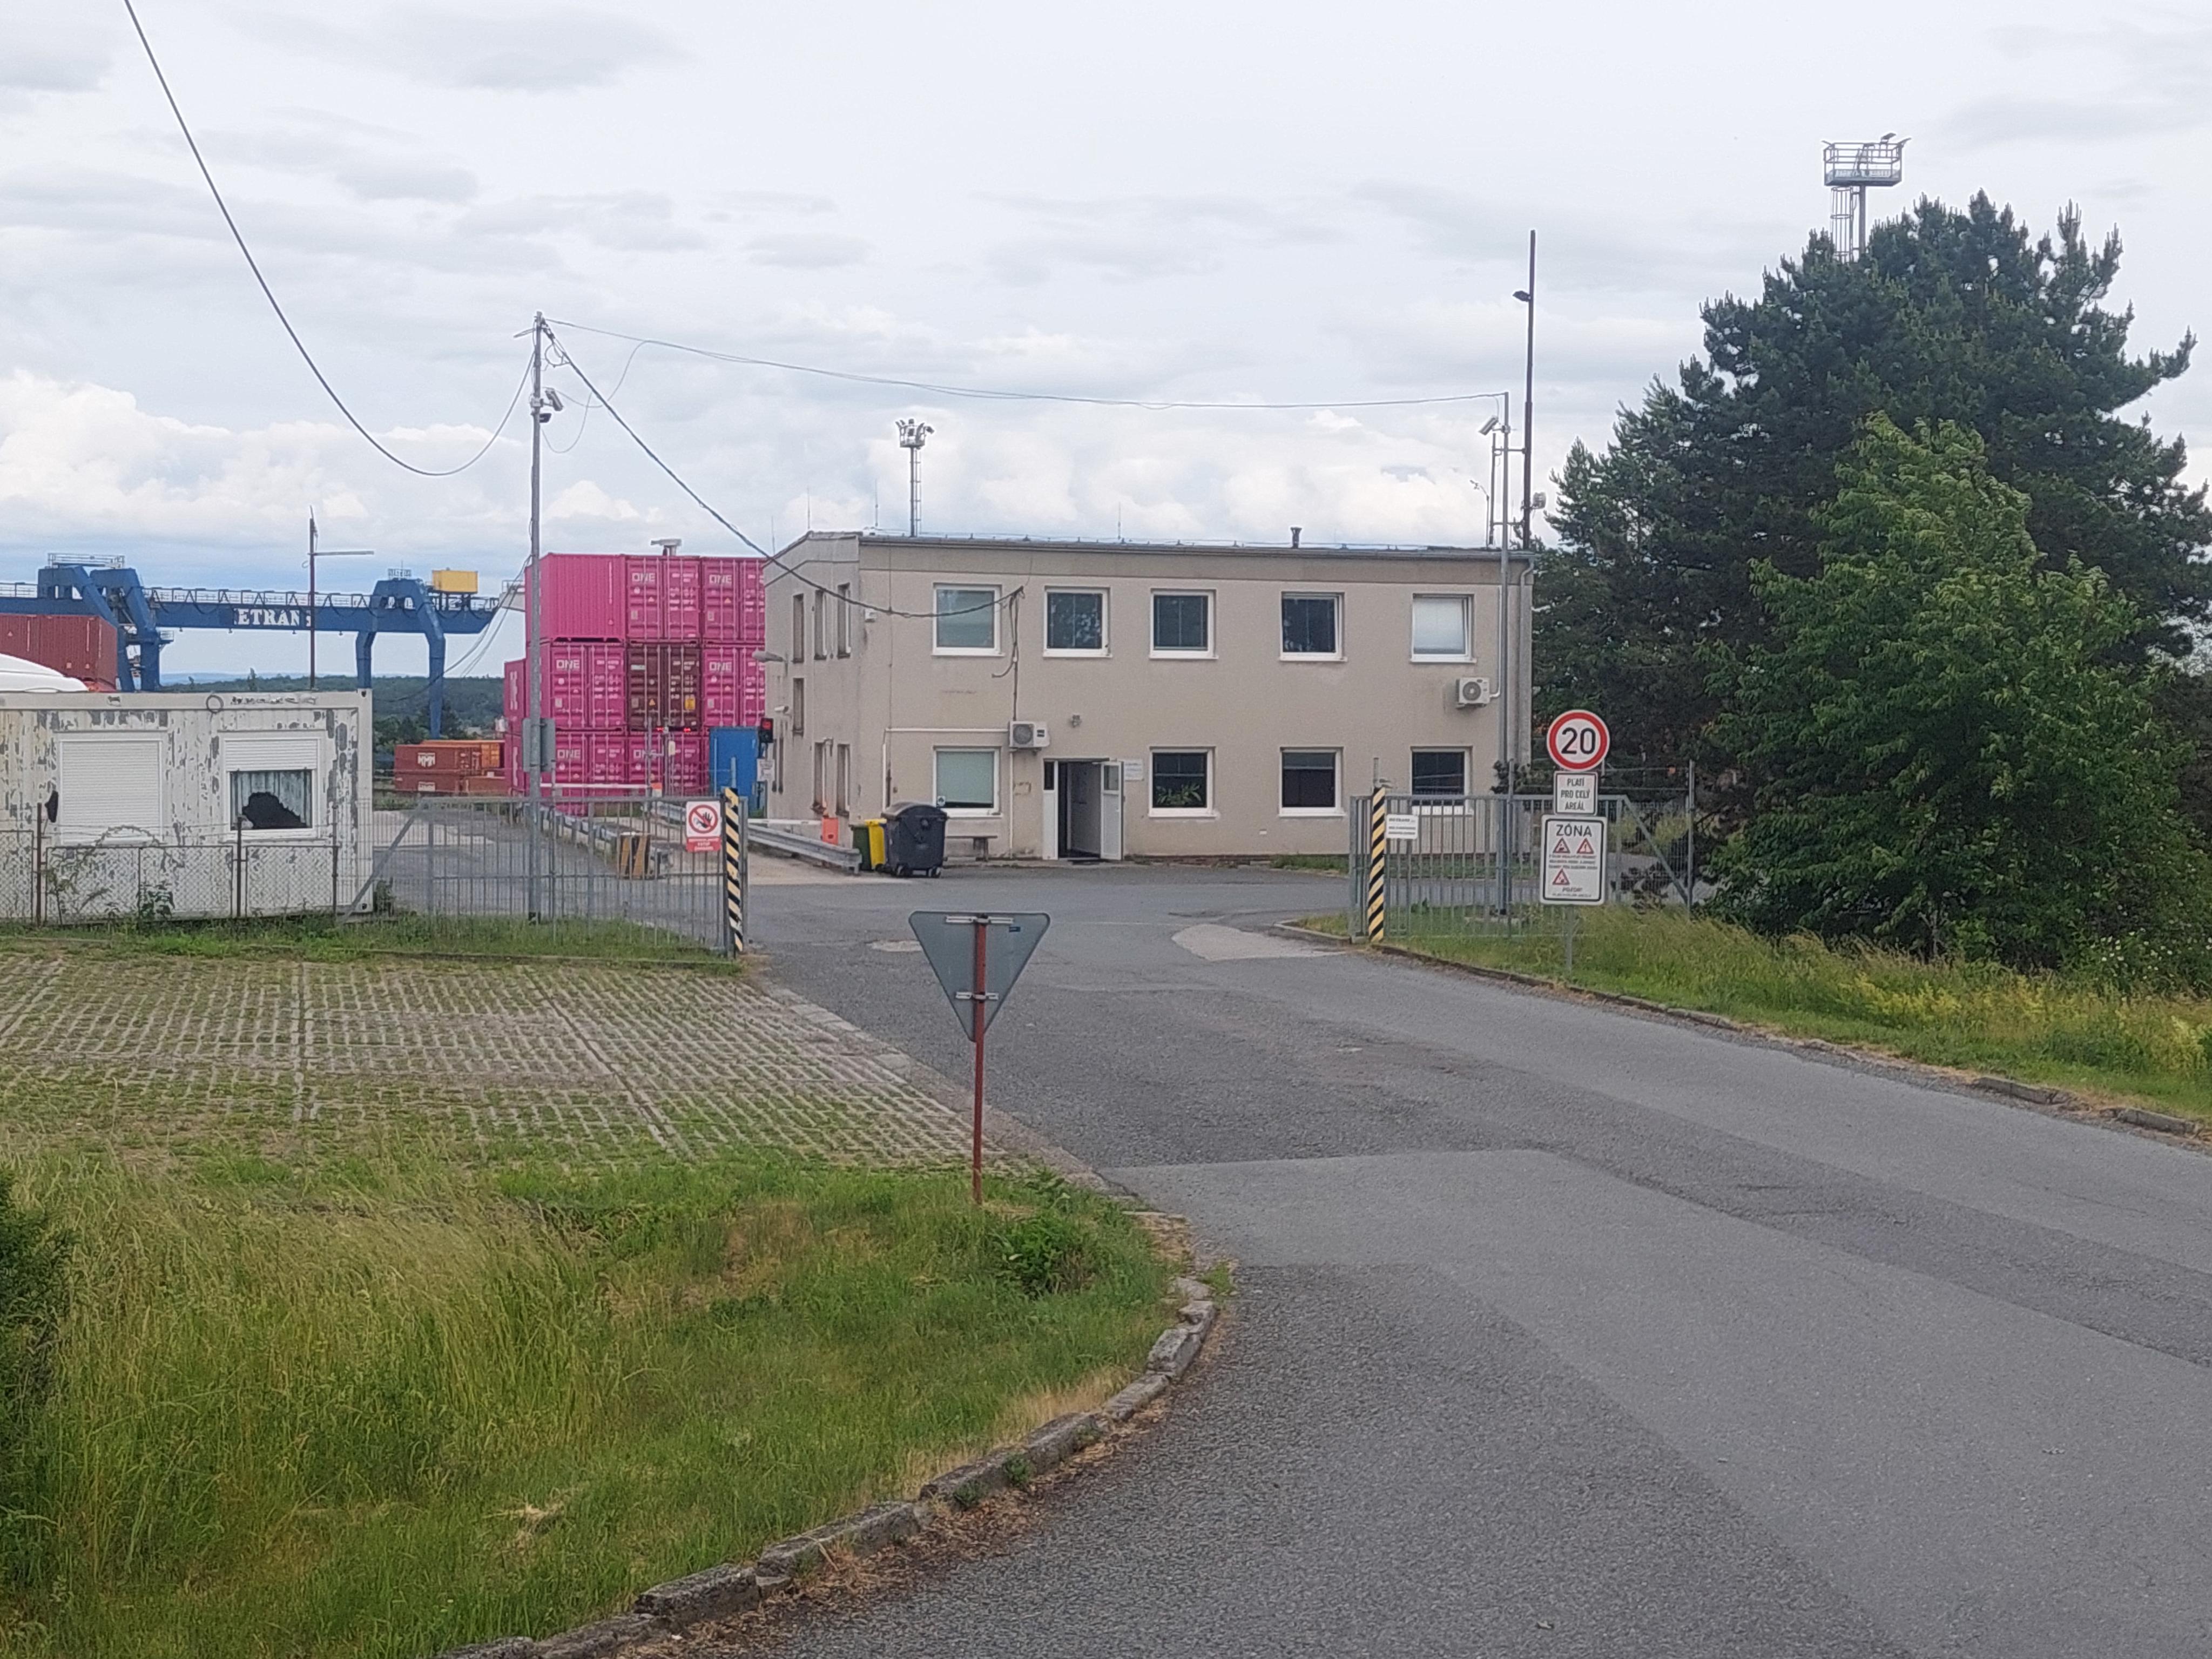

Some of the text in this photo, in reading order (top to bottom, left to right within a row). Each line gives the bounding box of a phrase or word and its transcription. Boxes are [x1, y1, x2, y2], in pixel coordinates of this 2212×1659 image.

[632, 572, 655, 582] ONE
[709, 574, 732, 584] ONE
[233, 608, 312, 627] ETRAN
[556, 659, 580, 669] ONE
[709, 662, 732, 671] ONE
[1561, 727, 1596, 754] 20
[557, 749, 581, 758] ONE
[1560, 789, 1574, 799] PRO
[1556, 823, 1593, 837] ZÓNA
